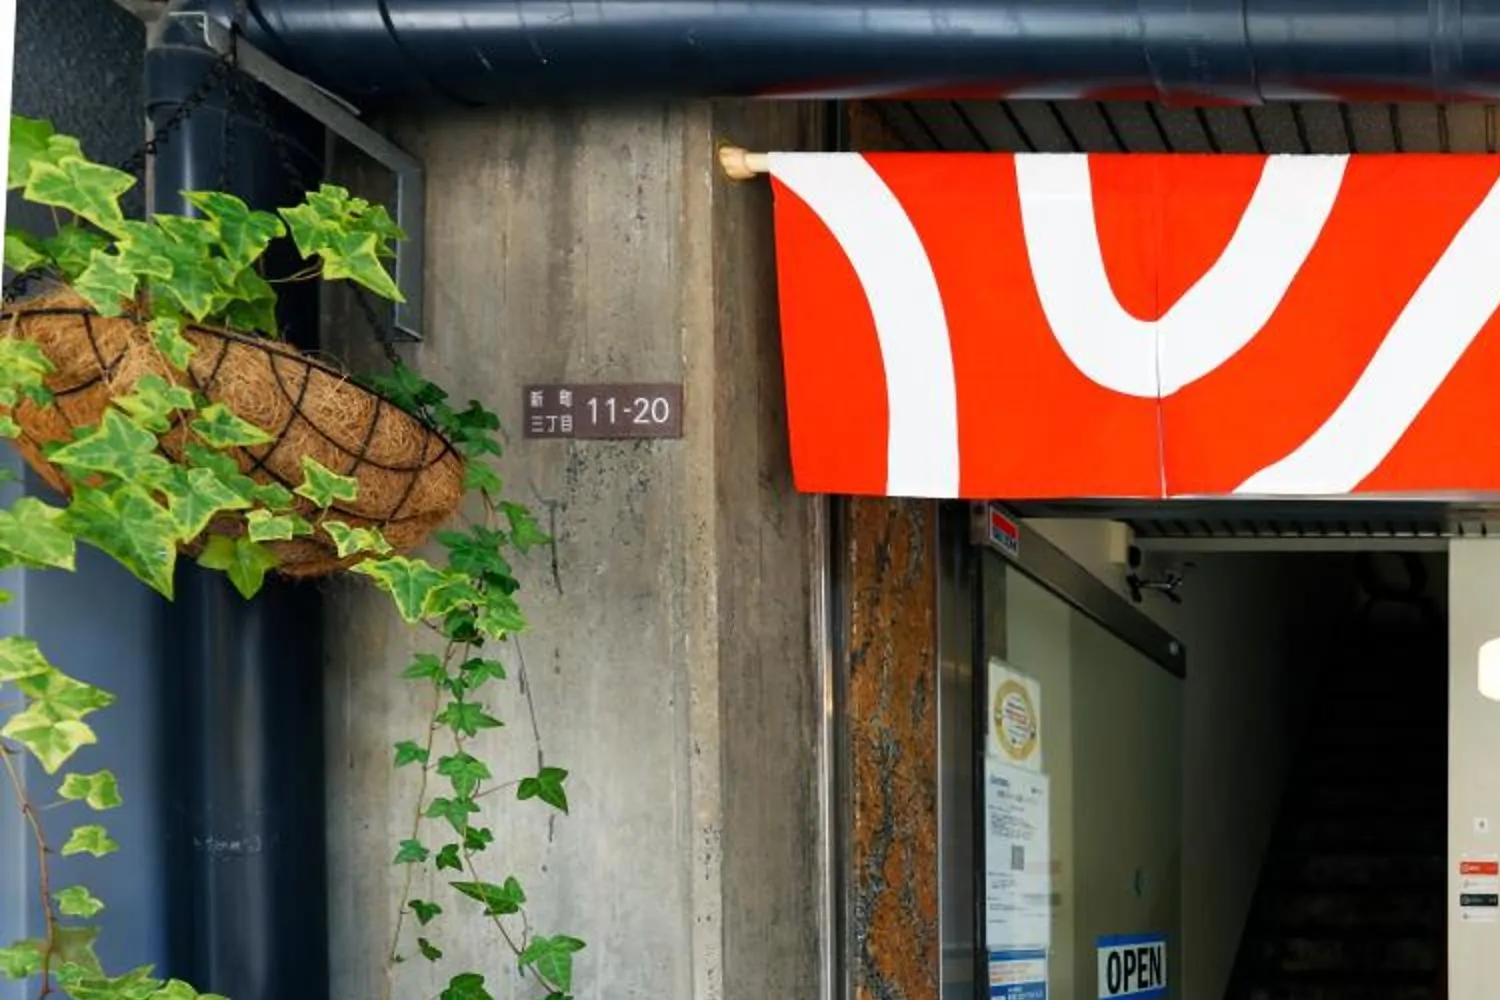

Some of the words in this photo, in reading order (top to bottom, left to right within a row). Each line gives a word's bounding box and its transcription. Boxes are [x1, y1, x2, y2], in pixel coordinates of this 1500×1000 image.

[531, 415, 573, 433] 三丁目
[587, 397, 670, 425] 11-20
[1107, 945, 1161, 994] OPEN
